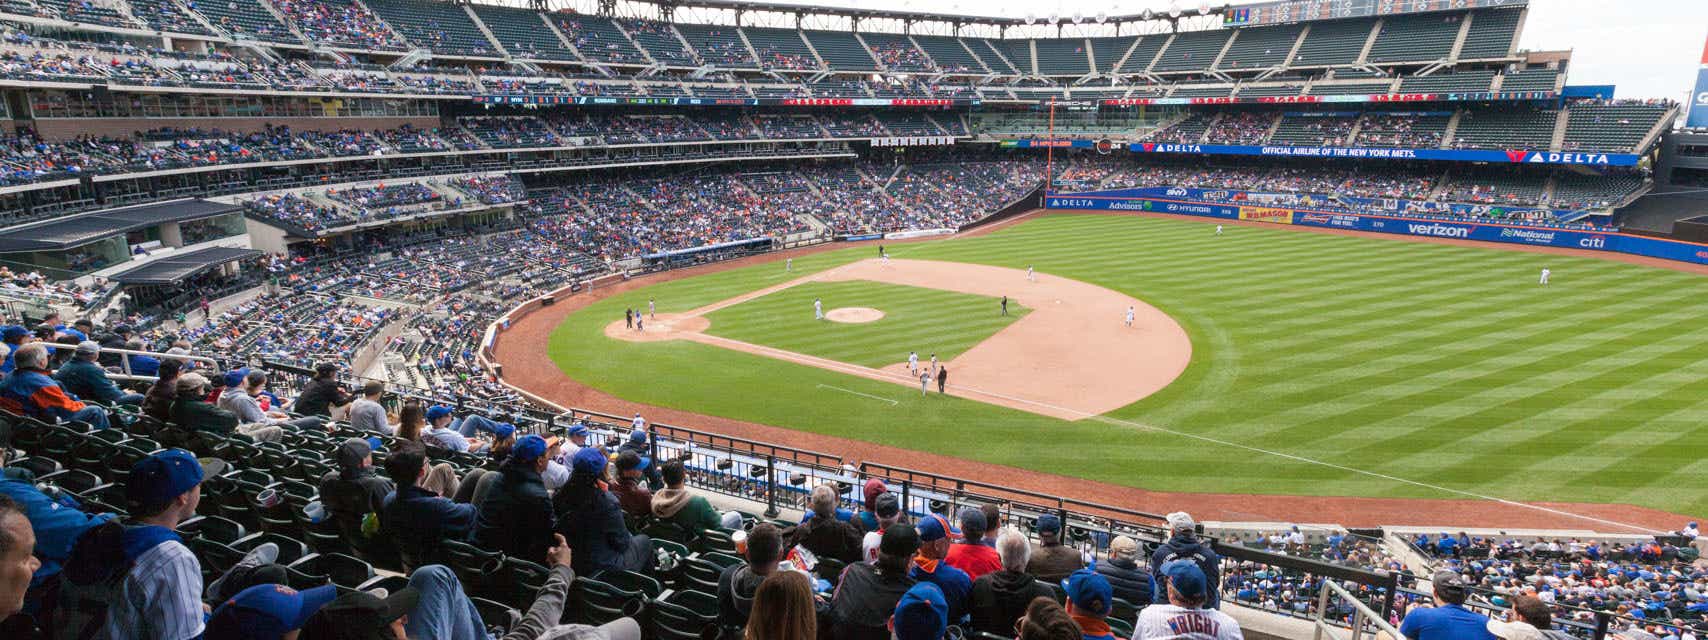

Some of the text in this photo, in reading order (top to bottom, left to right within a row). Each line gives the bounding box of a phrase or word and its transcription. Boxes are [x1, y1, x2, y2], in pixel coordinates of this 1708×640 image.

[1262, 146, 1292, 155] OFFICIAL
[1293, 147, 1320, 155] AIRLINE
[1321, 148, 1332, 156] OF
[1334, 148, 1347, 156] THE
[1368, 149, 1390, 157] YORK
[1391, 150, 1416, 158] METS.
[1549, 153, 1608, 163] DELTA
[1062, 199, 1093, 207] DELTA
[1179, 206, 1211, 214] HYUNDAI
[1408, 223, 1468, 238] verizon
[1513, 230, 1555, 240] National
[1580, 237, 1605, 248] citi
[1167, 614, 1220, 637] WRIGHT
